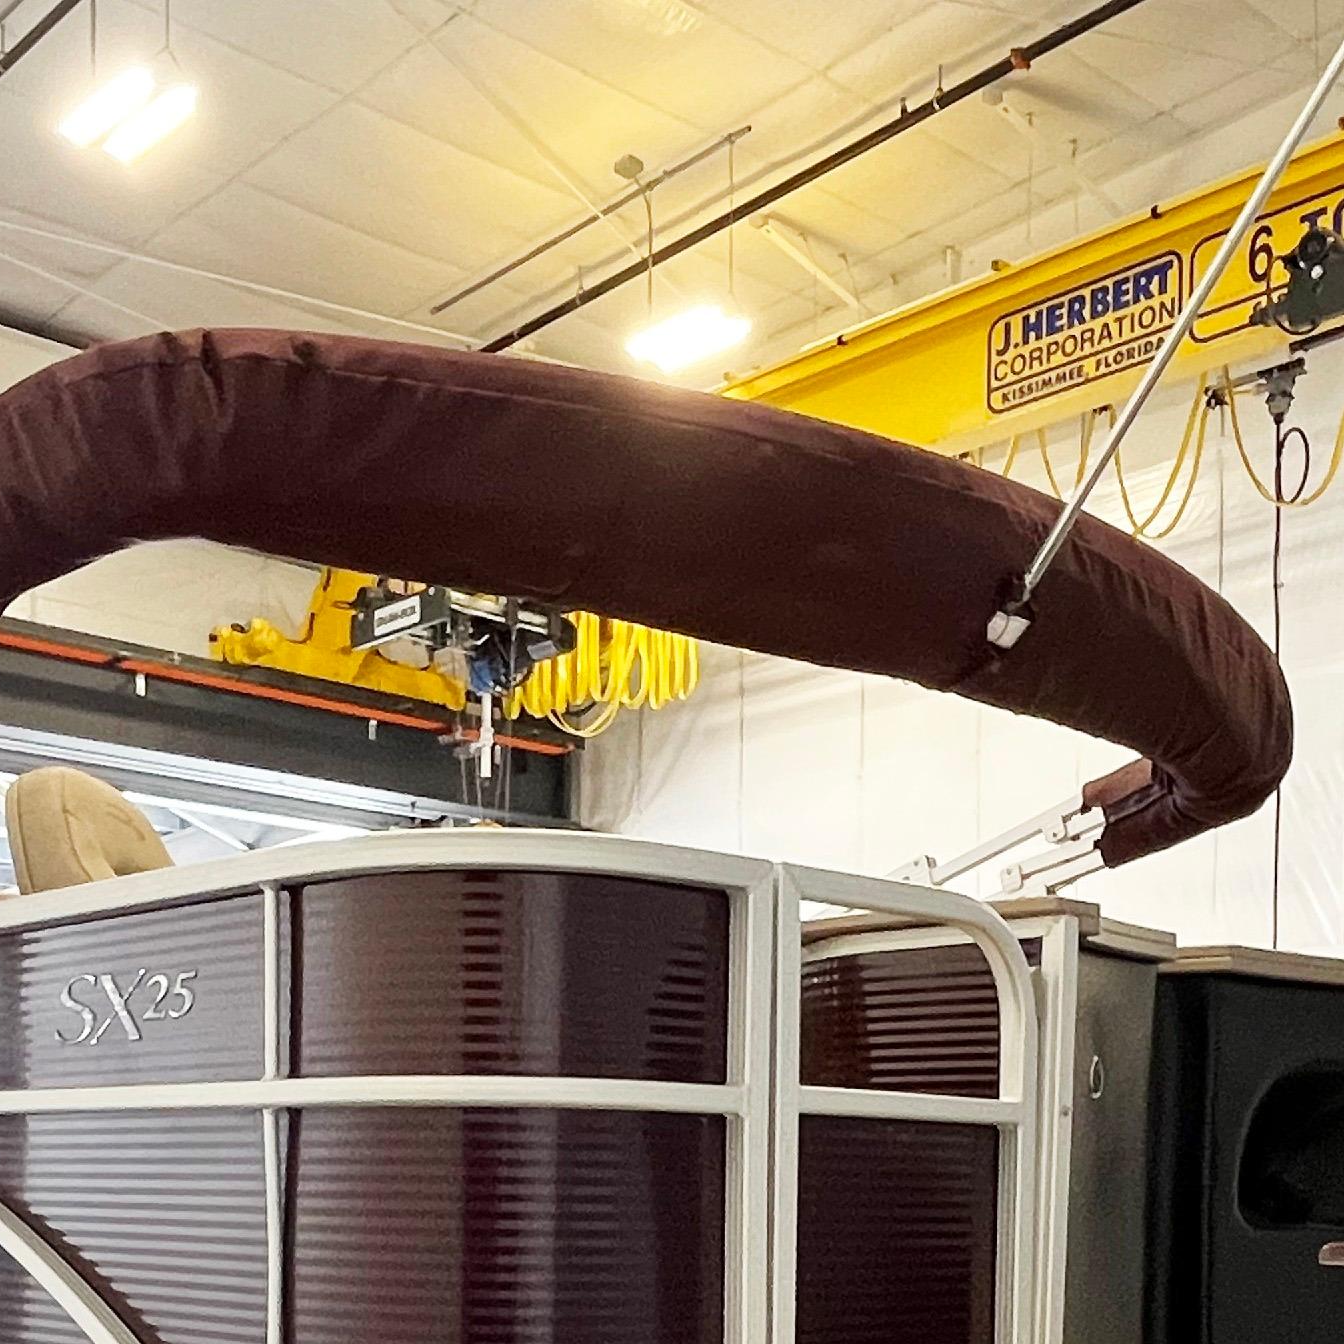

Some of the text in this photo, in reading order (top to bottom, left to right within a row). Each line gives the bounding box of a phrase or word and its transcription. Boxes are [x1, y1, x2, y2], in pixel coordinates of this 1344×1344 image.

[1248, 225, 1273, 283] 6
[994, 297, 1176, 382] CORPORATION
[995, 259, 1174, 357] J.HERBERT
